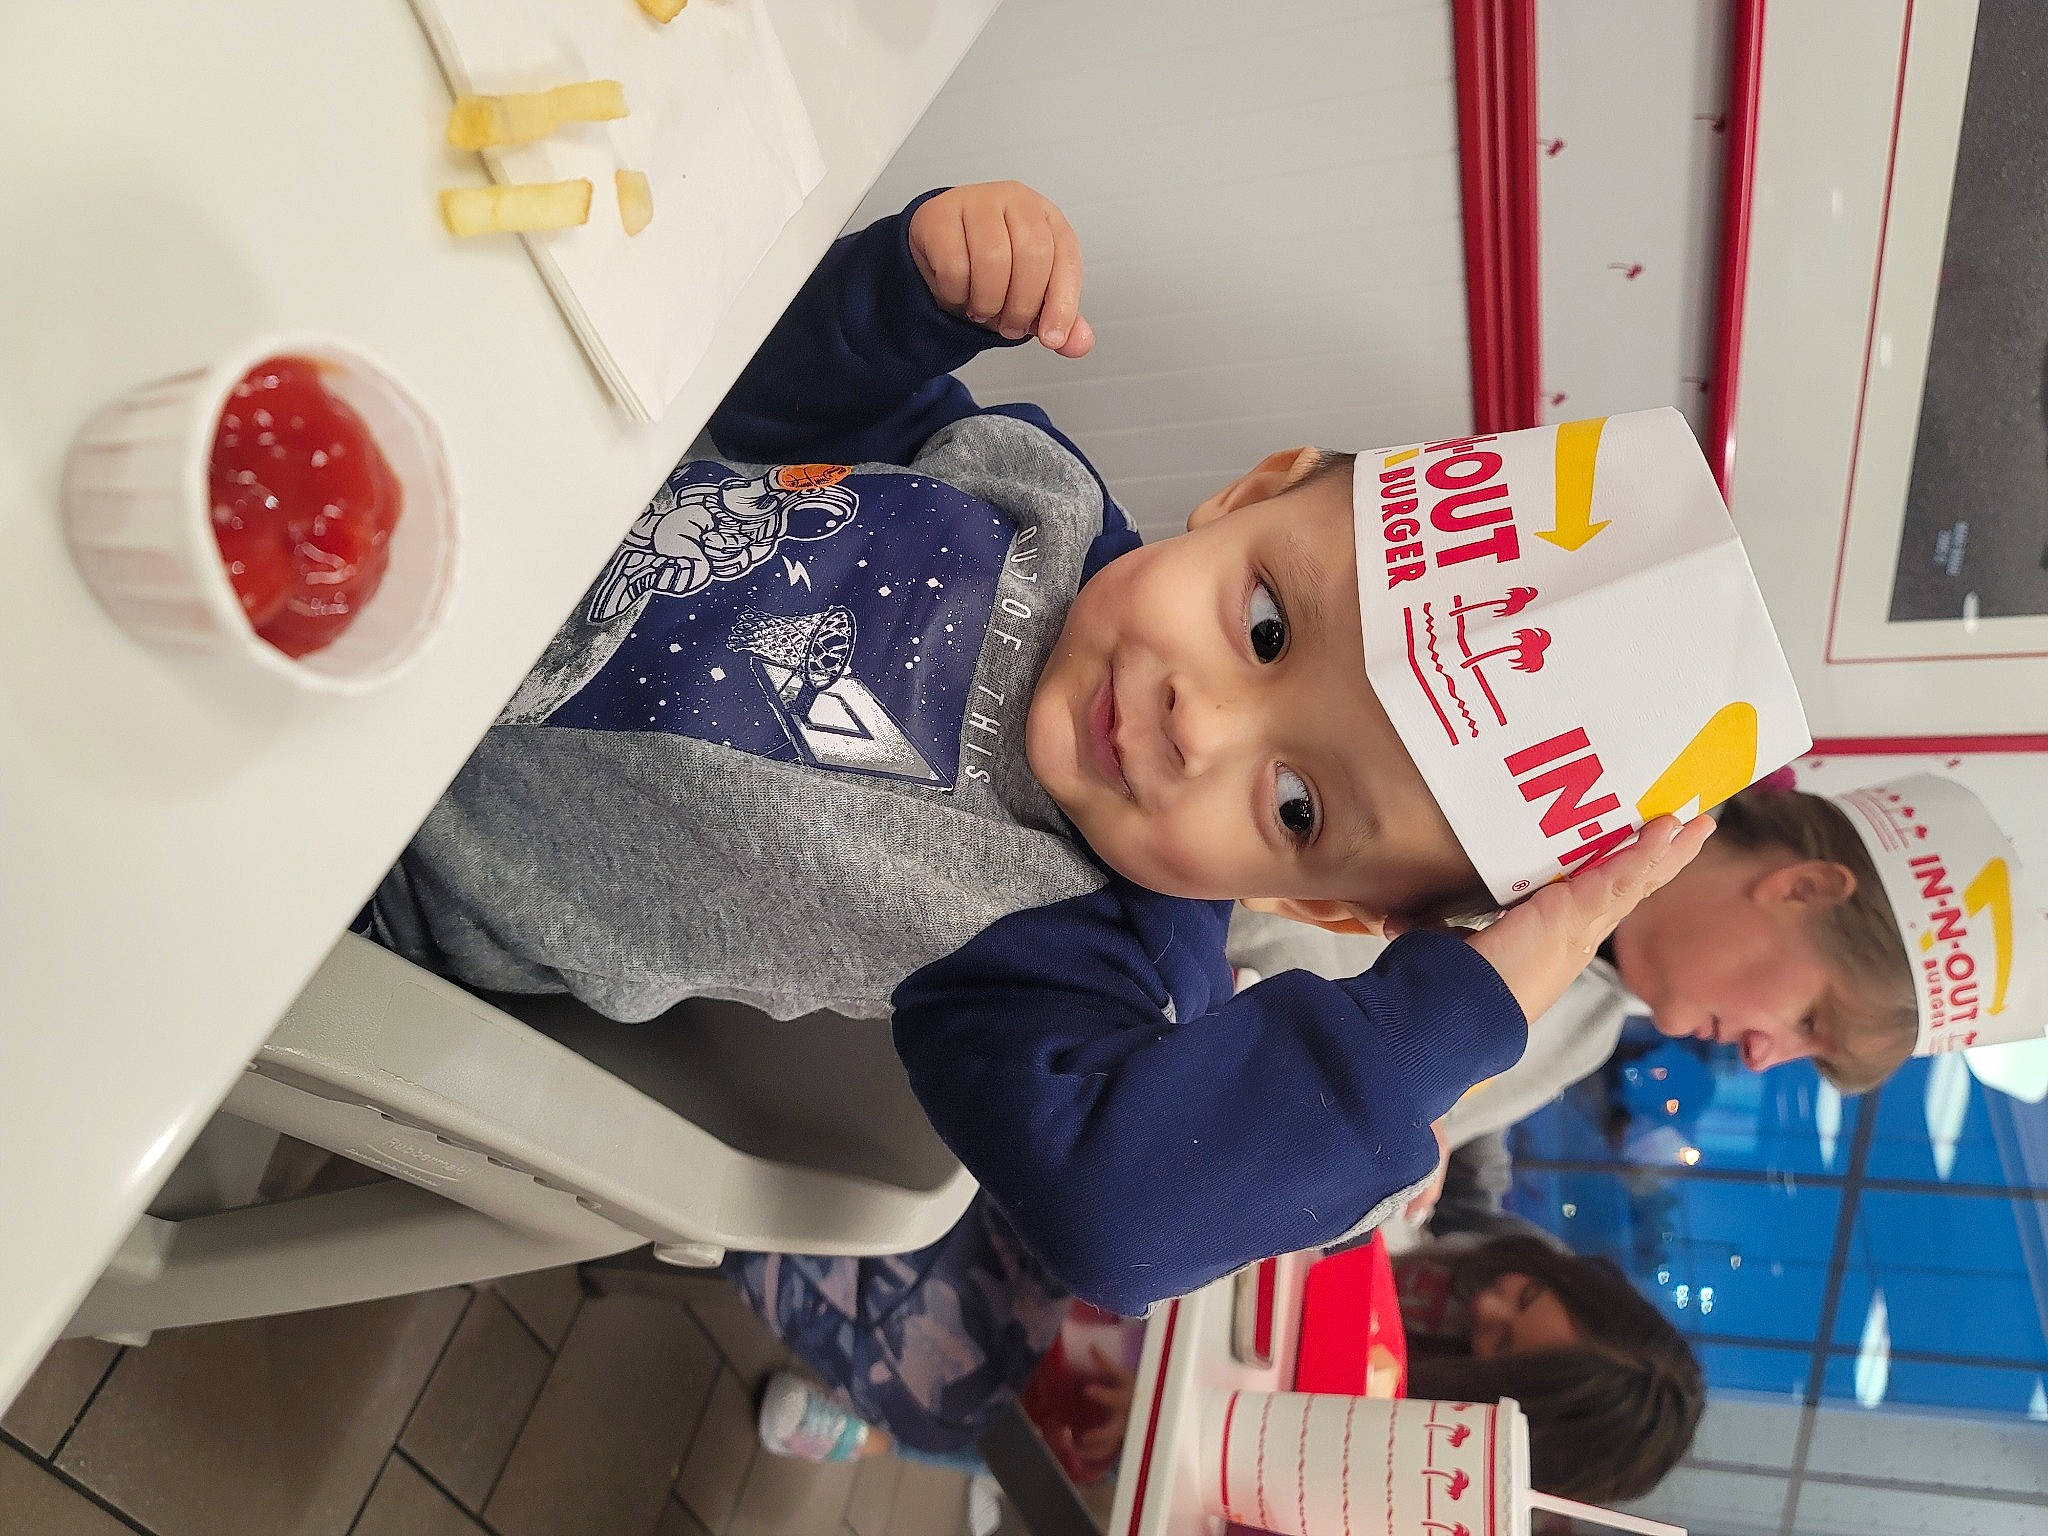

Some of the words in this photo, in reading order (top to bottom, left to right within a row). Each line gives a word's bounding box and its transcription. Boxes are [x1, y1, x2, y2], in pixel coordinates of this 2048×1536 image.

[1007, 525, 1039, 584] OUT
[1379, 466, 1427, 591] BURGER
[993, 598, 1032, 652] OF
[964, 684, 1005, 784] THIS
[1908, 854, 1979, 1023] IN-N-OUT
[1922, 958, 1946, 1030] BURGER
